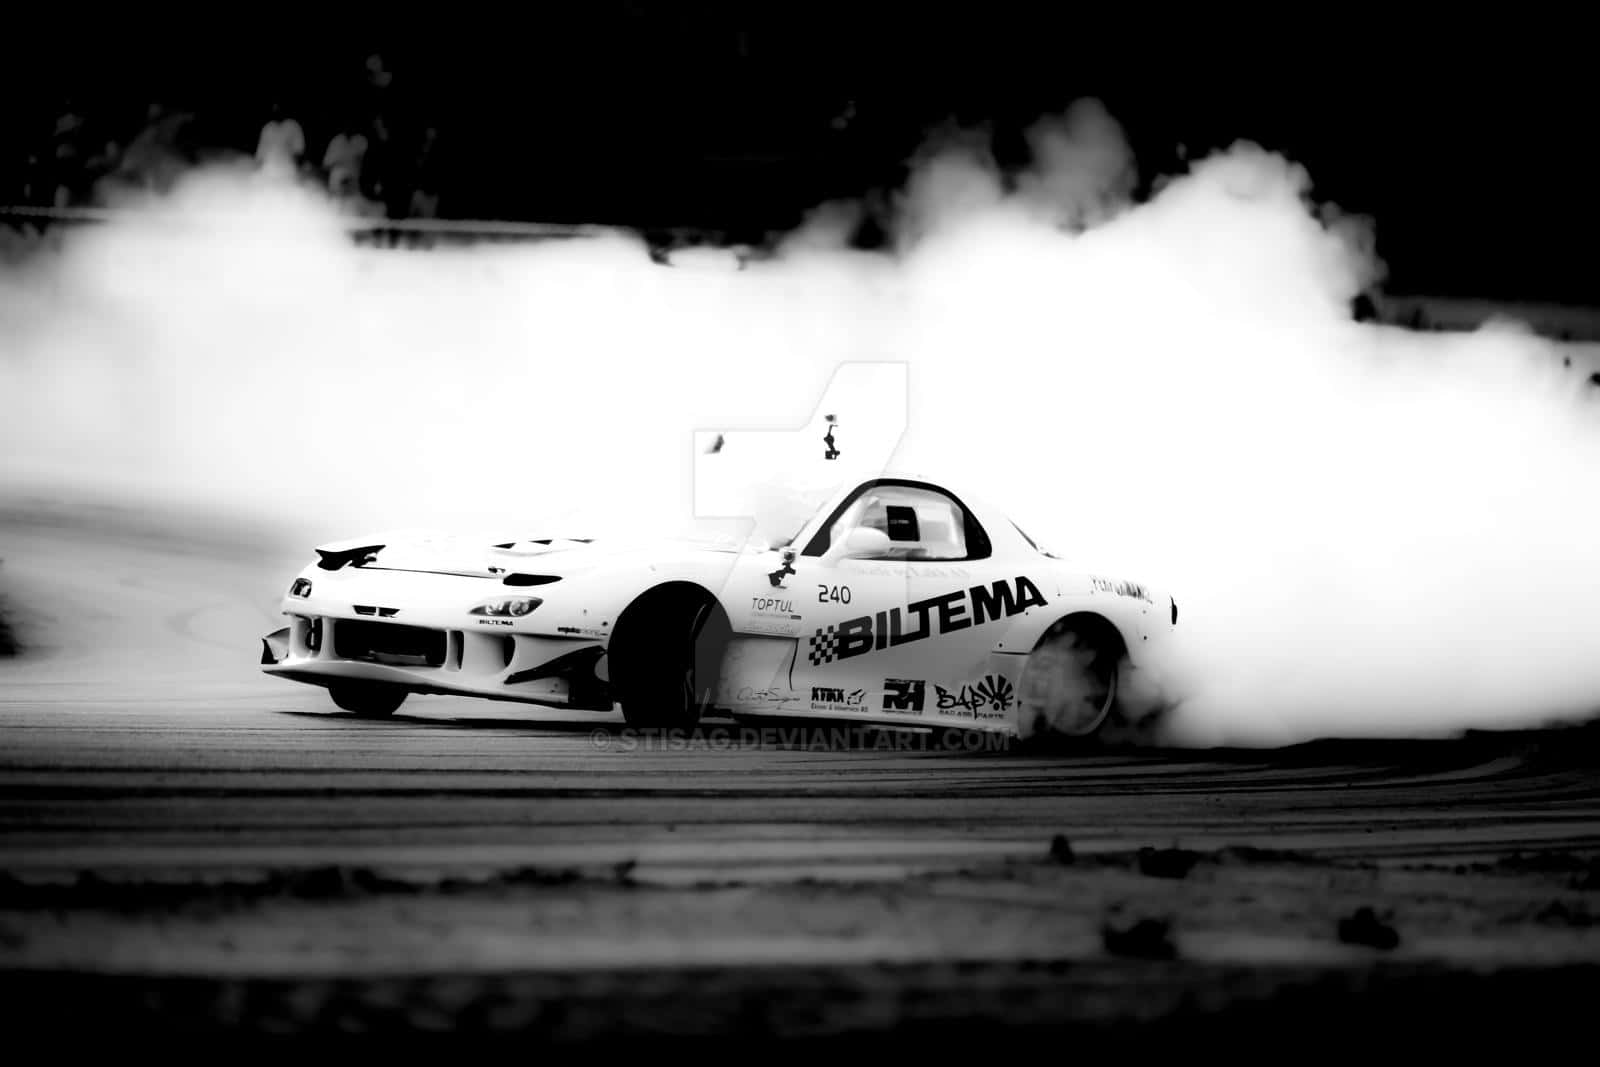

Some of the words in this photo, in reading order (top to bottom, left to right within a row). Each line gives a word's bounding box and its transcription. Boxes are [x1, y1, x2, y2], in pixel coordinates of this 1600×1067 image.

[818, 584, 851, 604] 240
[752, 597, 794, 612] TOPTUL
[836, 576, 1049, 660] BILTEMA
